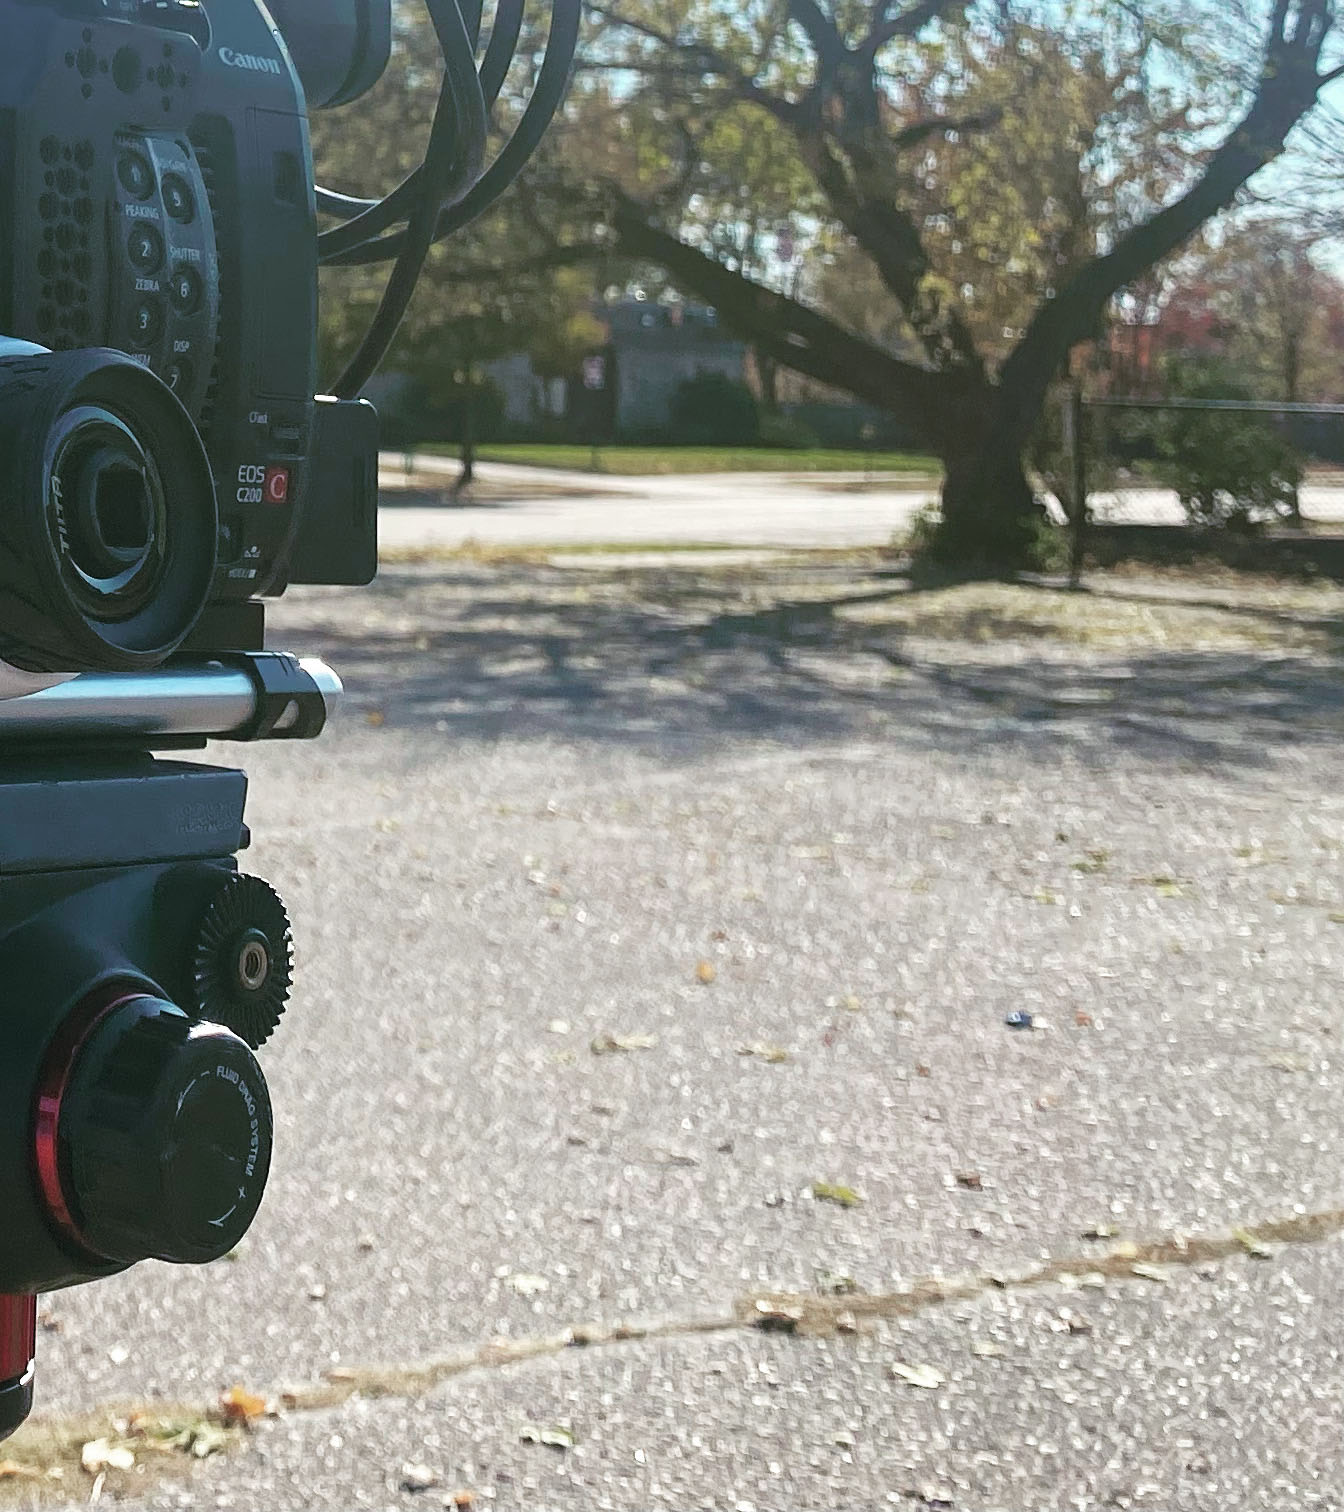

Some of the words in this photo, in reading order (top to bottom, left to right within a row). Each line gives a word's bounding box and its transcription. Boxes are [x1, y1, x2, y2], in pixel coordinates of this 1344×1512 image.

[218, 47, 281, 74] Canon
[124, 204, 160, 220] PEAKING
[141, 241, 151, 257] 2
[169, 247, 201, 261] SHUTTER
[134, 278, 160, 292] ZEBRA
[180, 281, 190, 298] 6
[139, 313, 148, 329] 3
[238, 465, 265, 484] EOS
[269, 474, 286, 499] C
[236, 488, 263, 503] C200
[216, 1065, 239, 1084] FLUID
[245, 1118, 259, 1177] SYSTEM
